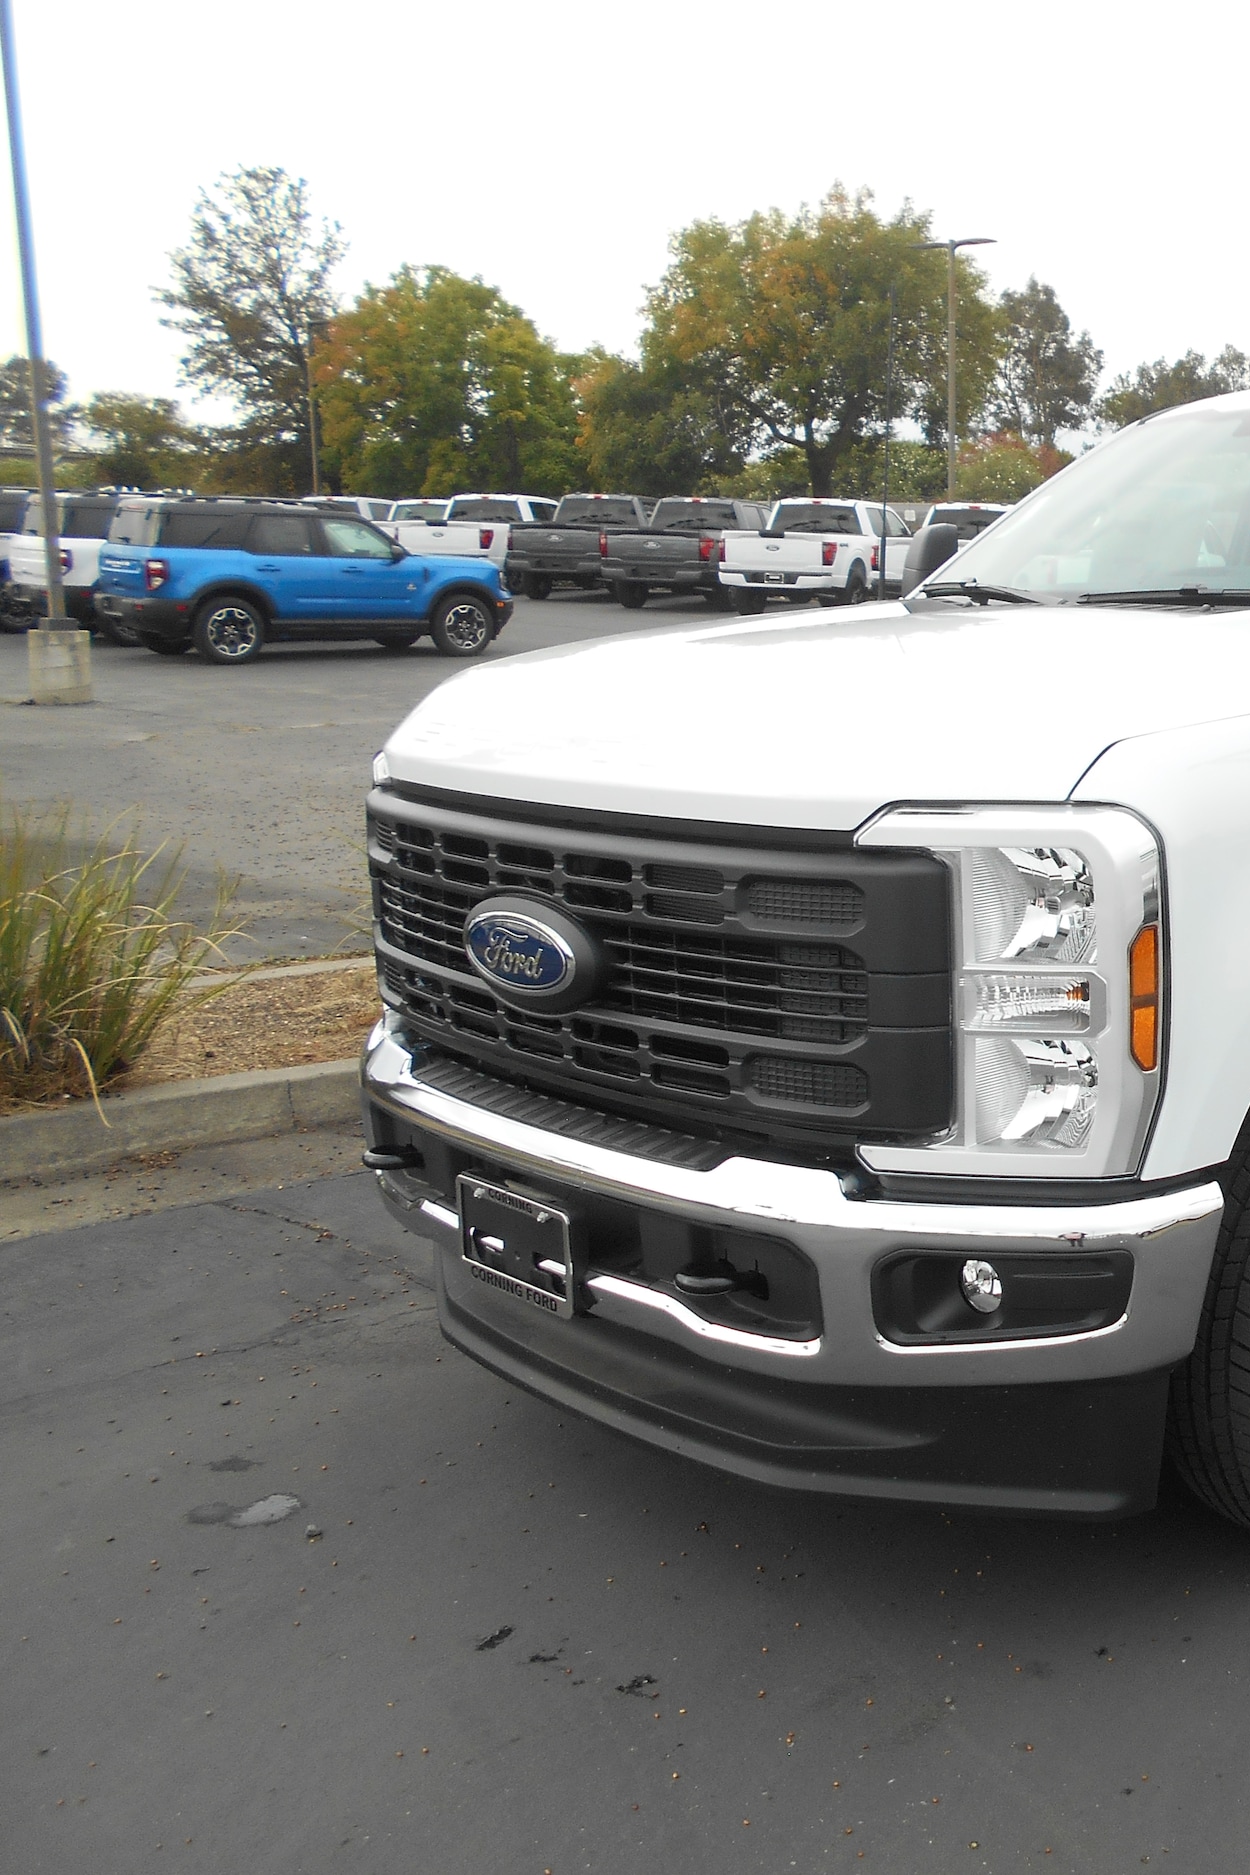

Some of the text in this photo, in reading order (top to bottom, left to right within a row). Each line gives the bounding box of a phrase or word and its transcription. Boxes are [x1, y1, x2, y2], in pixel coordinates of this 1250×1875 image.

[484, 926, 543, 979] Ford
[488, 1188, 533, 1214] CORNING
[471, 1265, 558, 1312] CORNING FORD
